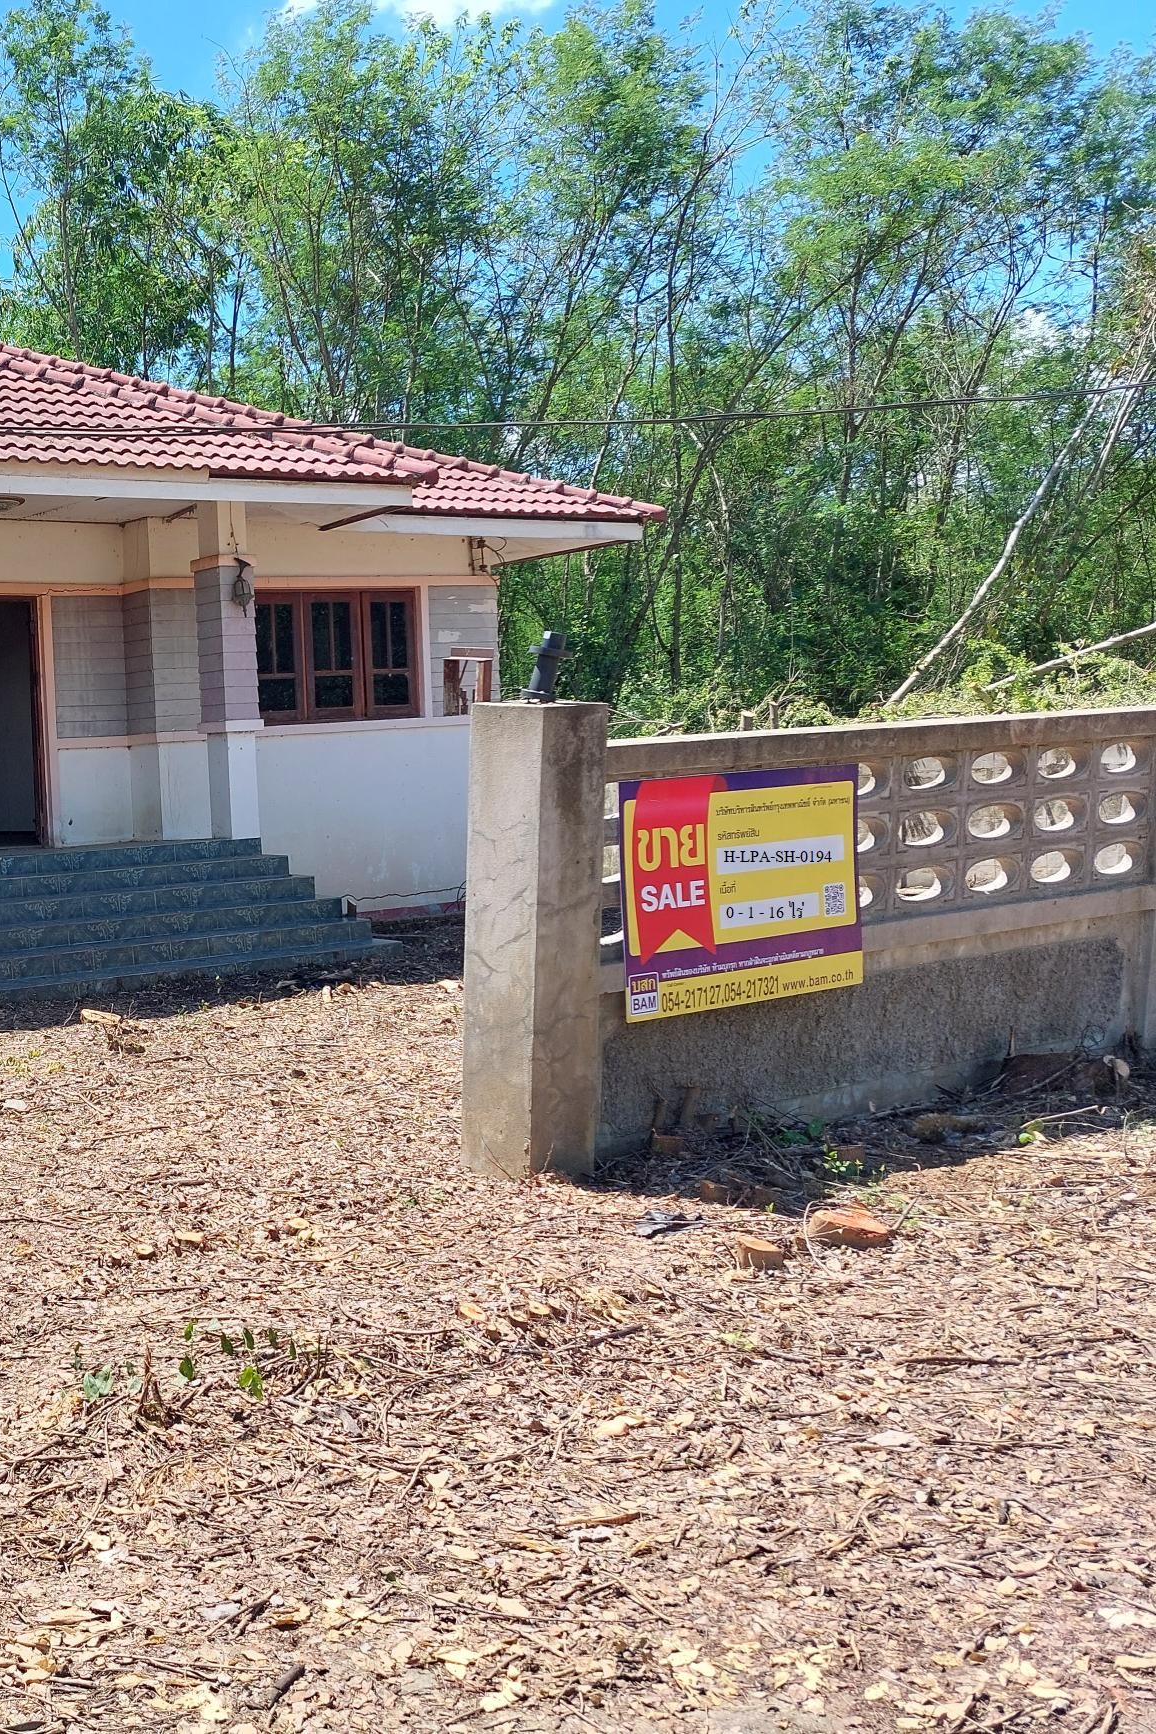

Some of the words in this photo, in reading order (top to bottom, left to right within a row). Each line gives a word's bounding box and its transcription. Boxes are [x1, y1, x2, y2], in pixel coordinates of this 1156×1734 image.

[637, 823, 706, 872] ขาย
[641, 880, 706, 912] SALE
[631, 978, 656, 993] บสก
[662, 976, 779, 1013] 054-217127,054-217321
[782, 968, 854, 992] www.bam.co.th
[633, 996, 656, 1012] BAM
